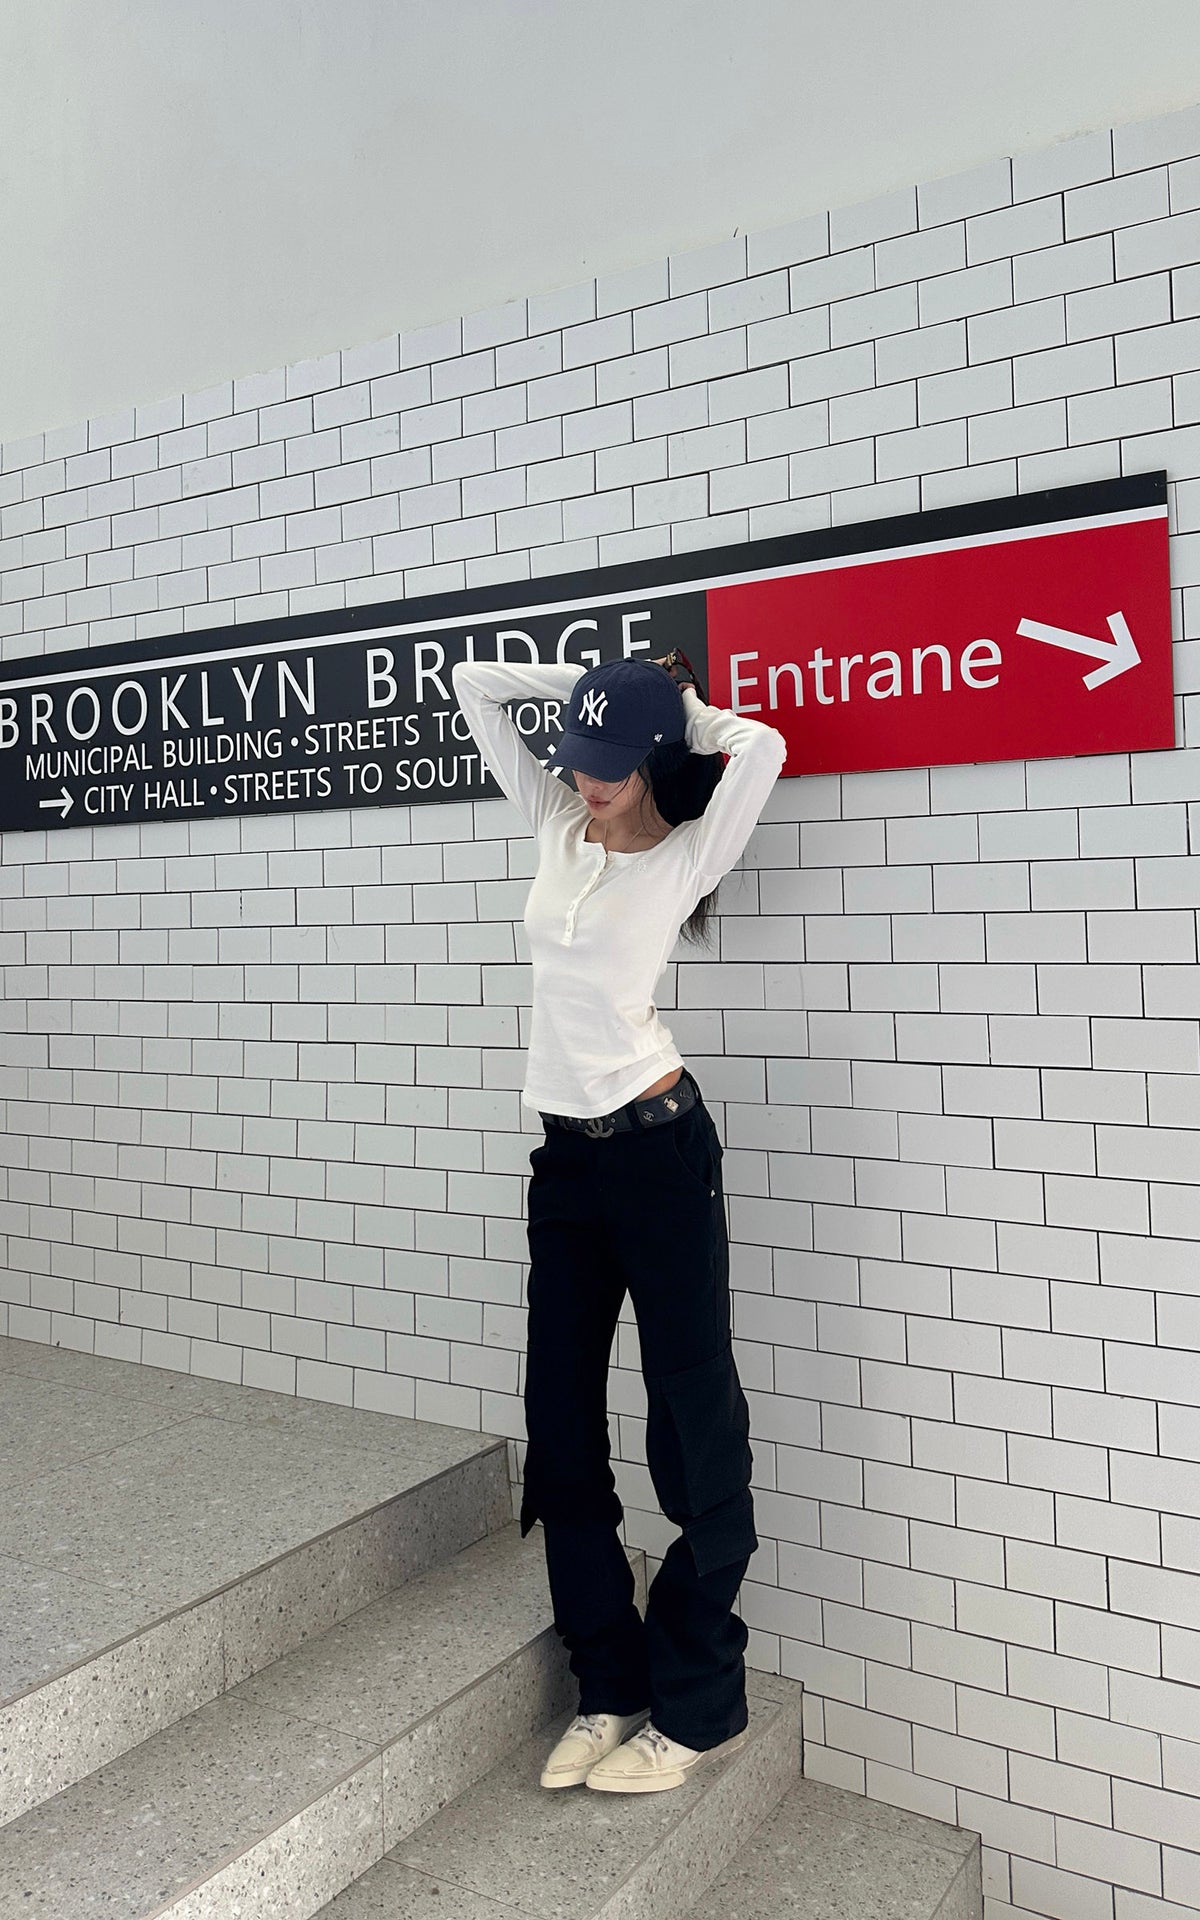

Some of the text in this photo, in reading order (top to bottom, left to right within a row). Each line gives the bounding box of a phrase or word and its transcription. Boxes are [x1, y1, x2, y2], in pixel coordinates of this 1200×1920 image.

[0, 656, 315, 749] BROOKLYN
[578, 688, 608, 727] NY
[729, 638, 1002, 714] Entrane
[26, 701, 570, 781] MUNICIPAL BUILDING STREETS TO OR
[84, 783, 134, 815] CITY
[144, 779, 205, 810] HALL
[224, 766, 332, 804] STREETS
[343, 763, 383, 795] TO
